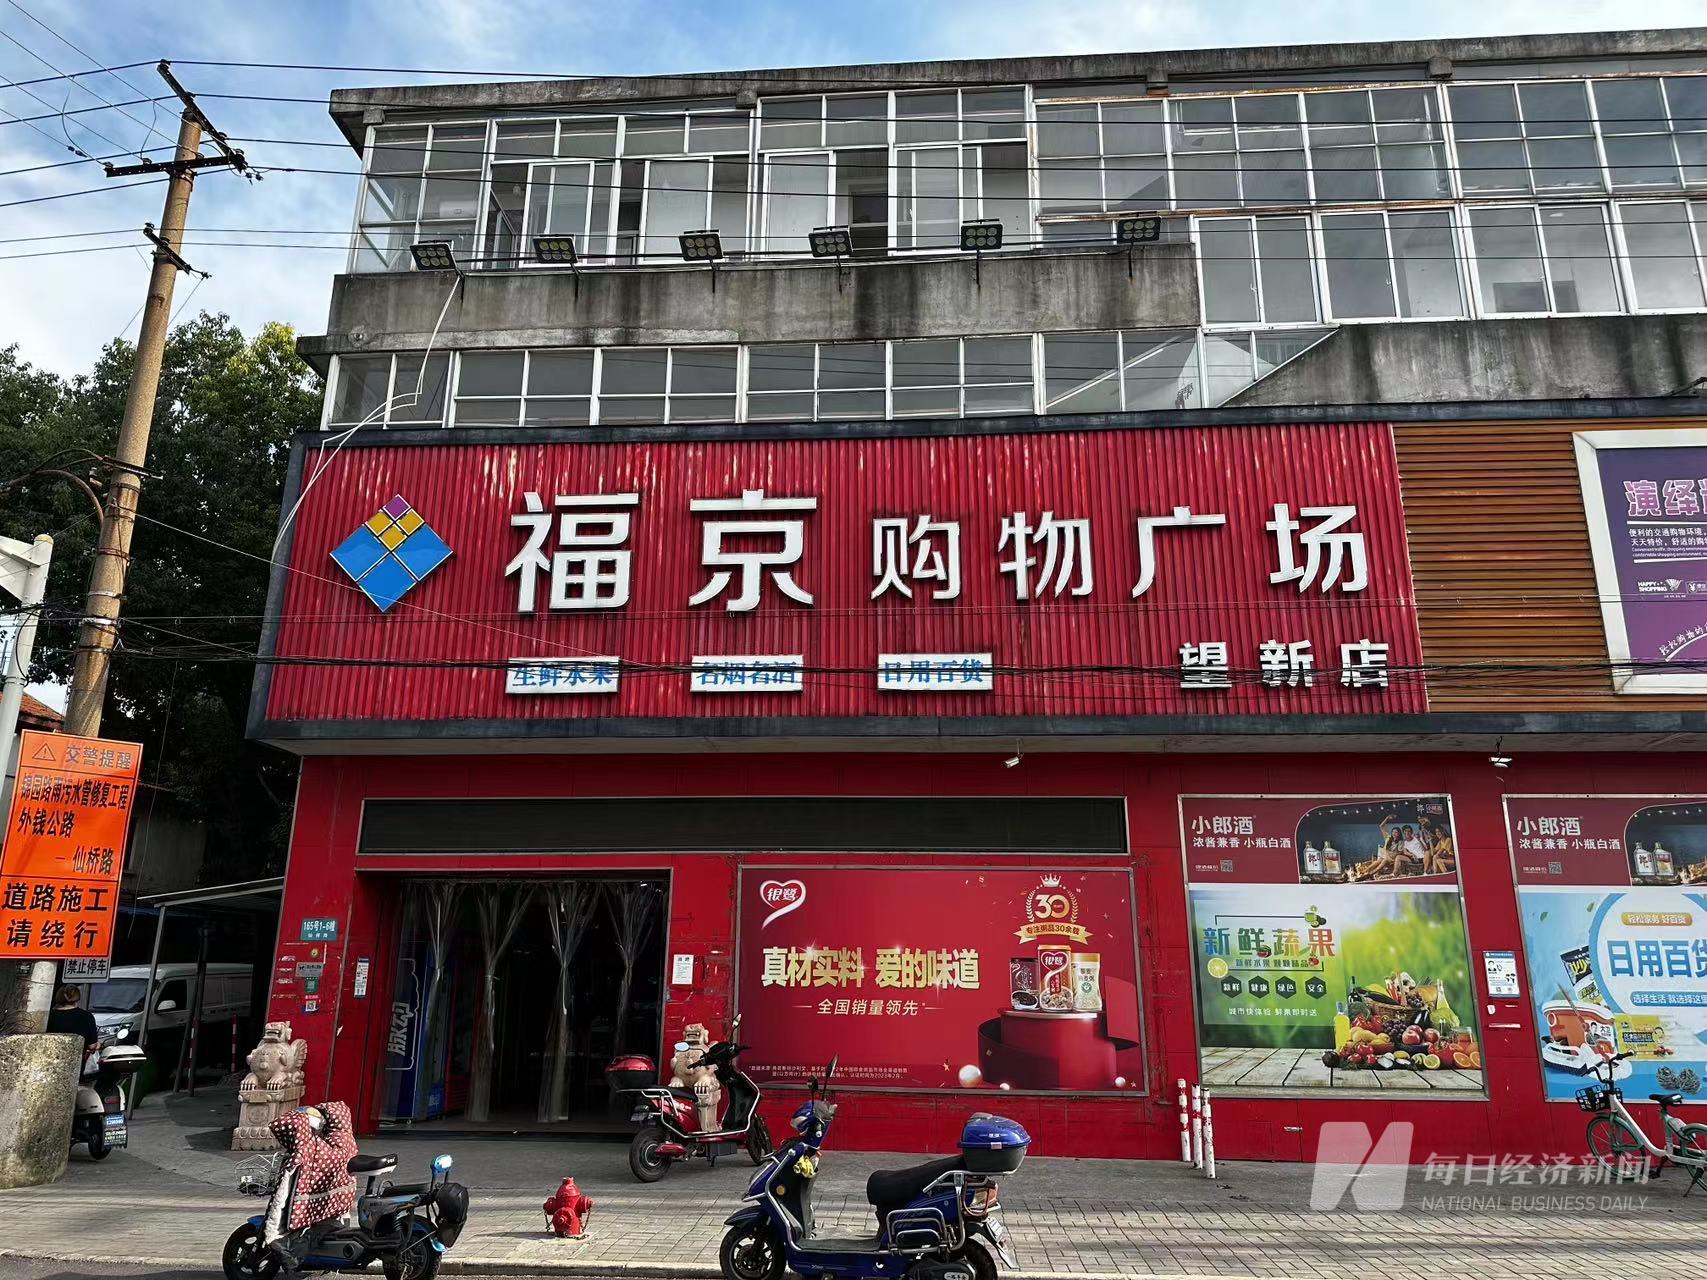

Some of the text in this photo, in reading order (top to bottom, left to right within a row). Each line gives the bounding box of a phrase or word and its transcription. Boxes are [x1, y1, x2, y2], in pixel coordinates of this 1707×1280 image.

[1623, 480, 1707, 516] 演绎
[505, 489, 1368, 613] 福京购物广场
[884, 658, 983, 684] 日用百货
[1179, 639, 1389, 688] 望新店
[65, 744, 131, 770] 交警提醒
[17, 806, 75, 838] 外钱公路
[1192, 815, 1253, 835] 小郎酒
[1517, 816, 1581, 836] 小郎酒
[1193, 837, 1291, 848] 浓酱兼香 小瓶白酒
[1519, 838, 1621, 850] 浓酱兼香 小瓶白酒
[72, 845, 114, 875] 仙桥路
[1, 882, 109, 912] 道路施工
[767, 888, 797, 901] 银鹭
[1034, 894, 1070, 919] 30
[7, 918, 98, 949] 请绕行
[1203, 927, 1336, 957] 新鲜蔬果
[66, 958, 107, 975] 禁止停车
[761, 946, 865, 988] 真材实料
[874, 947, 980, 990] 爱的味道
[1307, 983, 1325, 993] 安全
